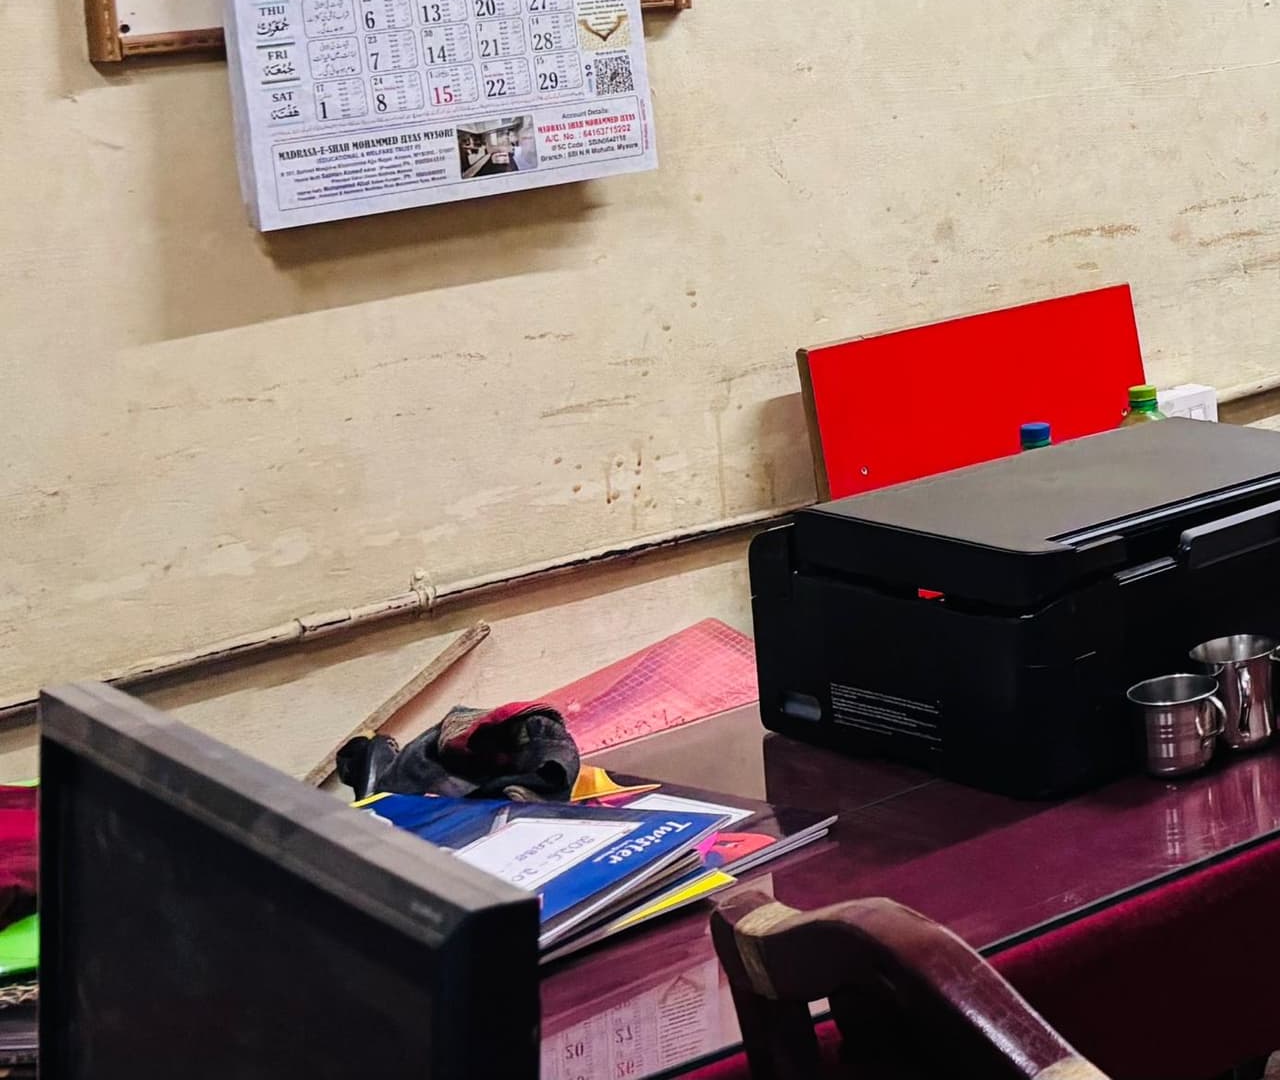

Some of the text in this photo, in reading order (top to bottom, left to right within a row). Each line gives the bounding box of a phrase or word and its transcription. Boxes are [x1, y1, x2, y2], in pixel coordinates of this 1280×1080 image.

[259, 6, 285, 16] THU
[422, 4, 441, 23] 13
[475, 0, 496, 17] 20
[365, 11, 375, 29] 6
[481, 39, 500, 57] 21
[533, 32, 553, 51] 28
[268, 50, 288, 60] FRI
[371, 53, 380, 70] 7
[427, 45, 447, 64] 14
[487, 79, 506, 97] 22
[539, 72, 558, 90] 29
[272, 92, 294, 102] SAT
[377, 94, 387, 112] 8
[434, 86, 453, 104] 15
[321, 102, 328, 119] 1
[279, 143, 350, 161] MADRASA-E-SHAH
[352, 136, 398, 150] MOHAMMED
[424, 129, 454, 140] MYSORE
[610, 821, 693, 865] Twister
